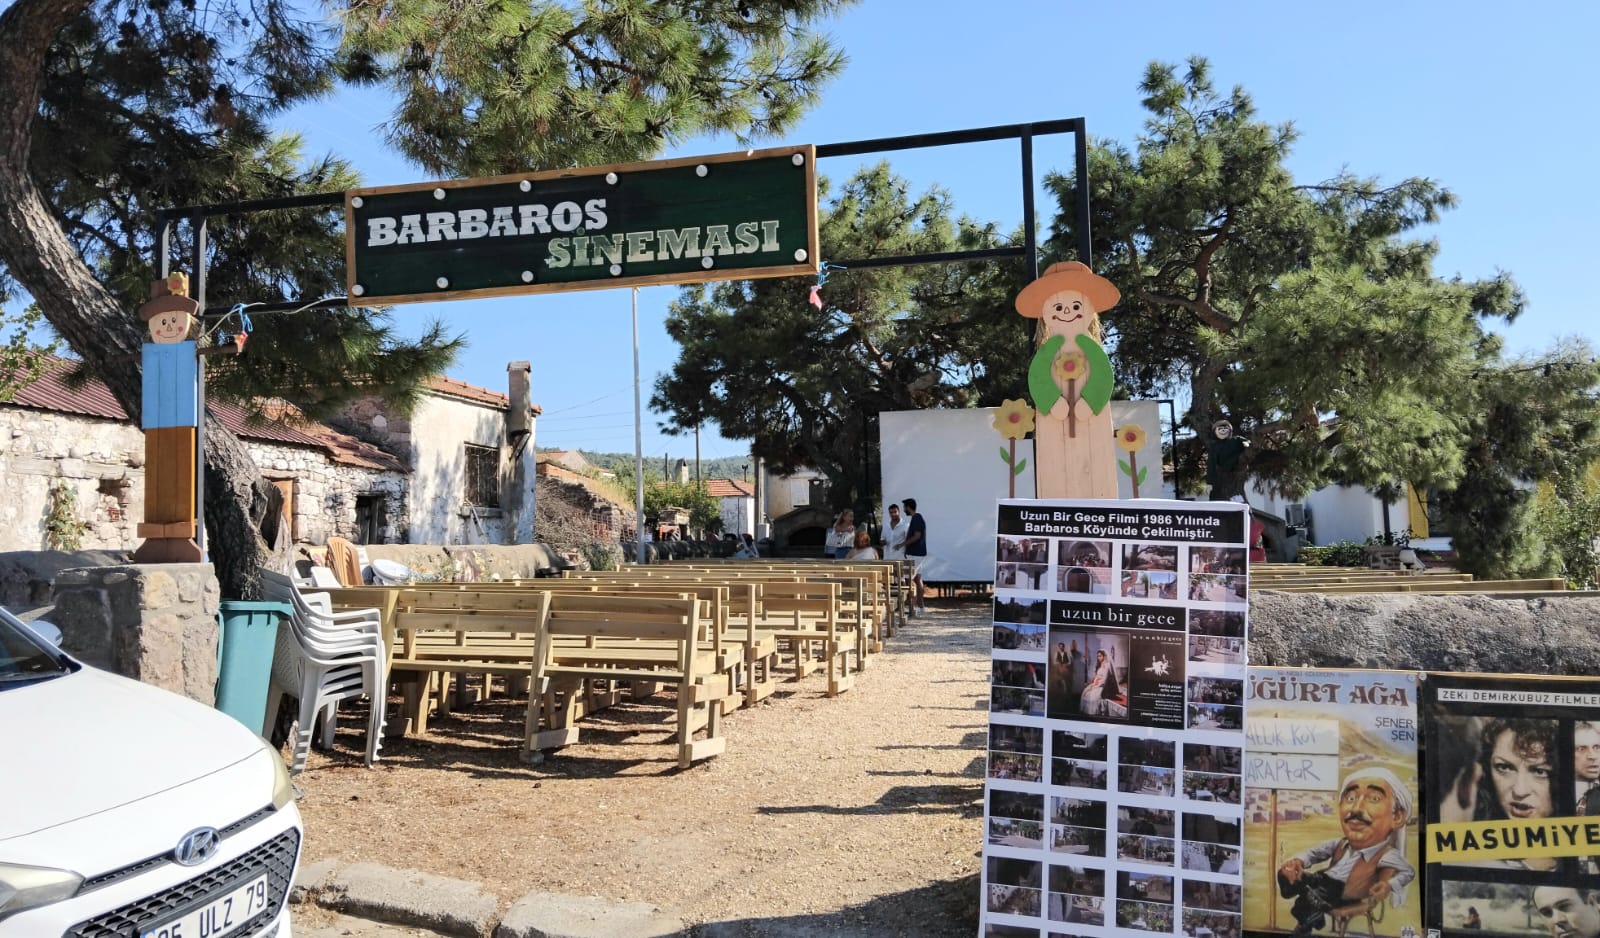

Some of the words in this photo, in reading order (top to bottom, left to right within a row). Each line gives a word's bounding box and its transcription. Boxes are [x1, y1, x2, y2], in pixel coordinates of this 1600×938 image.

[367, 199, 607, 247] BARBAROS
[546, 219, 780, 269] SİNEMASI
[1020, 510, 1050, 521] Uzun
[1053, 511, 1071, 522] Bir
[1074, 512, 1105, 523] Gece
[1109, 513, 1139, 524] Filmi
[1143, 514, 1172, 525] 1986
[1175, 515, 1220, 526] Yılında
[1025, 522, 1080, 534] Barbaros
[1083, 524, 1138, 538] Köyünde
[1141, 526, 1214, 540] Çekilmiştir.
[1062, 609, 1102, 621] uzun
[1108, 607, 1133, 622] bir
[1137, 613, 1176, 626] gece
[1348, 682, 1409, 709] AĞA
[1375, 717, 1414, 731] ŞENER
[1391, 730, 1415, 742] ŞEN
[200, 897, 233, 938] ULZ
[246, 880, 265, 915] 79
